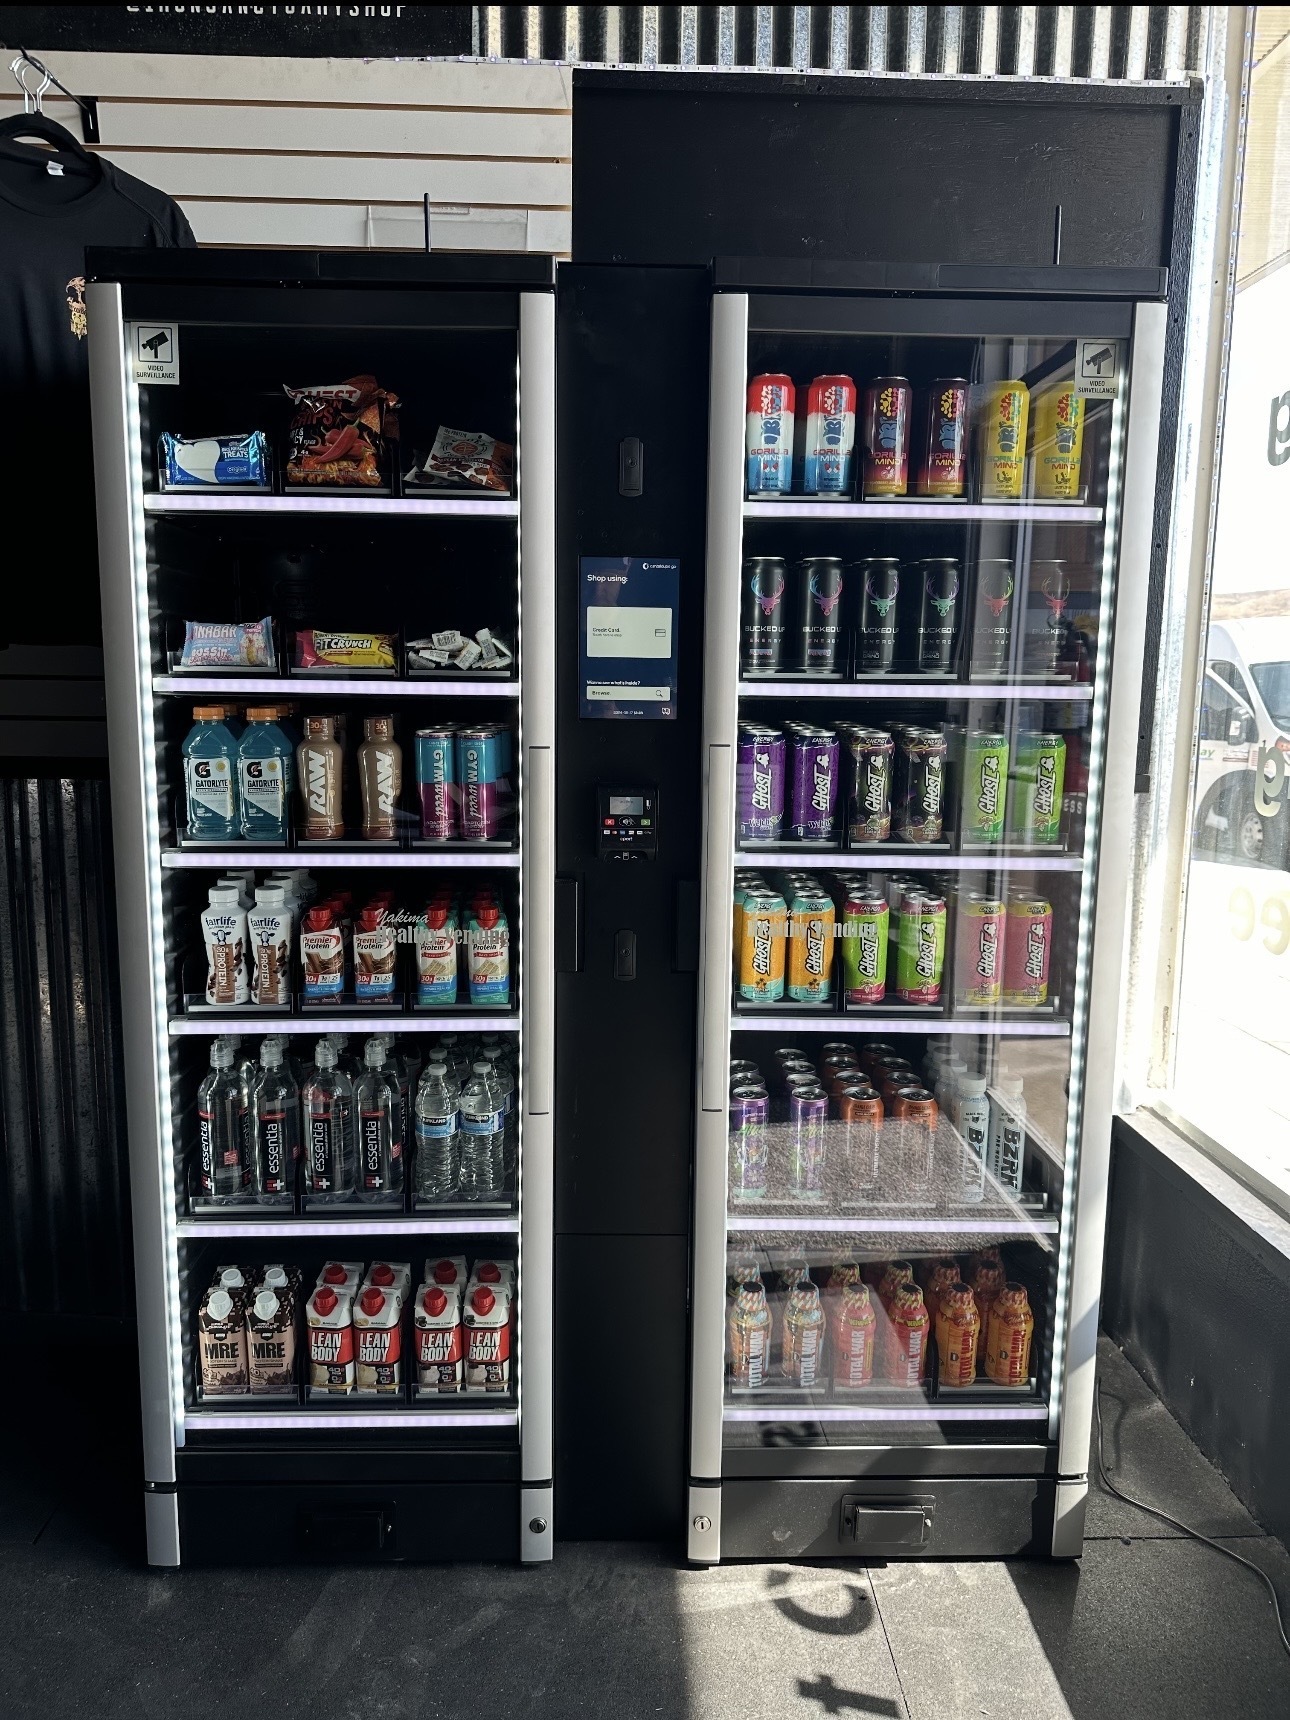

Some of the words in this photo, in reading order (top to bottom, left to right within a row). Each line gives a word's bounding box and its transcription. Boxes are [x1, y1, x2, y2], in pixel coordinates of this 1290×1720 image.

[136, 371, 175, 379] SURVEILLANCE
[587, 574, 606, 582] Shop
[607, 574, 628, 584] using:
[195, 779, 228, 788] GATORLYTE
[247, 780, 279, 788] GATORLYTE
[752, 762, 772, 811] GHOST
[811, 763, 831, 812] GHOST
[864, 764, 887, 813] GHOST
[922, 765, 942, 813] GHOST
[978, 765, 1000, 816] GHOST
[1033, 765, 1056, 816] GHOST
[374, 907, 430, 926] Yakima
[303, 936, 332, 944] Premier
[375, 925, 438, 948] Healthy
[444, 926, 510, 948] Vending
[752, 930, 772, 976] GHOST
[805, 928, 825, 976] GHOST
[217, 952, 228, 986] PROTEIN
[260, 954, 271, 988] PROTEIN
[858, 934, 878, 978] GHOST
[915, 931, 937, 978] GHOST
[976, 930, 998, 978] GHOST
[1025, 930, 1045, 979] GHOST
[200, 1121, 210, 1171] essentia
[266, 1123, 280, 1173] essentia
[313, 1122, 325, 1172] essentia
[365, 1120, 378, 1171] essentia
[311, 1332, 342, 1347] LEAN
[311, 1347, 340, 1361] BODY
[359, 1347, 389, 1362] BODY
[360, 1332, 391, 1347] LEAN
[420, 1346, 451, 1361] BODY
[421, 1331, 454, 1347] LEAN
[468, 1346, 500, 1361] BODY
[470, 1331, 502, 1346] LEAN
